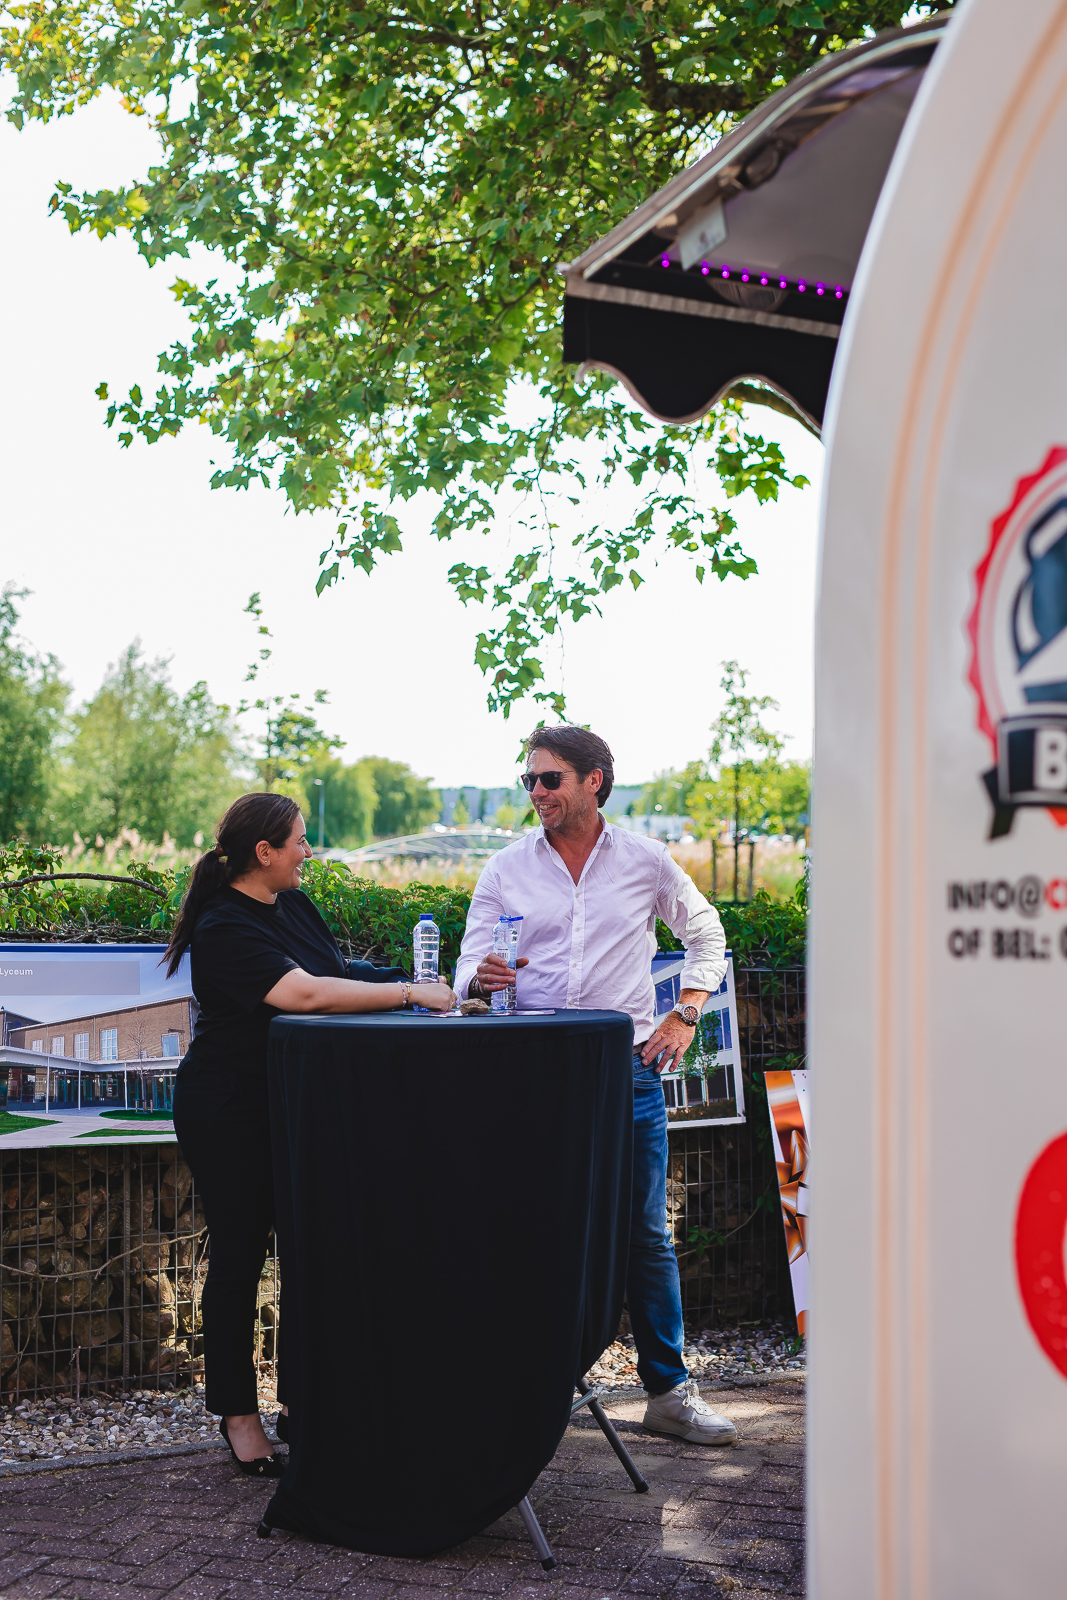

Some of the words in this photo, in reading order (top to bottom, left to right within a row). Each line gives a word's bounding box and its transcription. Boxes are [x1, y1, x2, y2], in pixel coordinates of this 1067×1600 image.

[948, 928, 981, 958] OF
[993, 928, 1050, 959] BEL:
[0, 968, 33, 977] Lyceum
